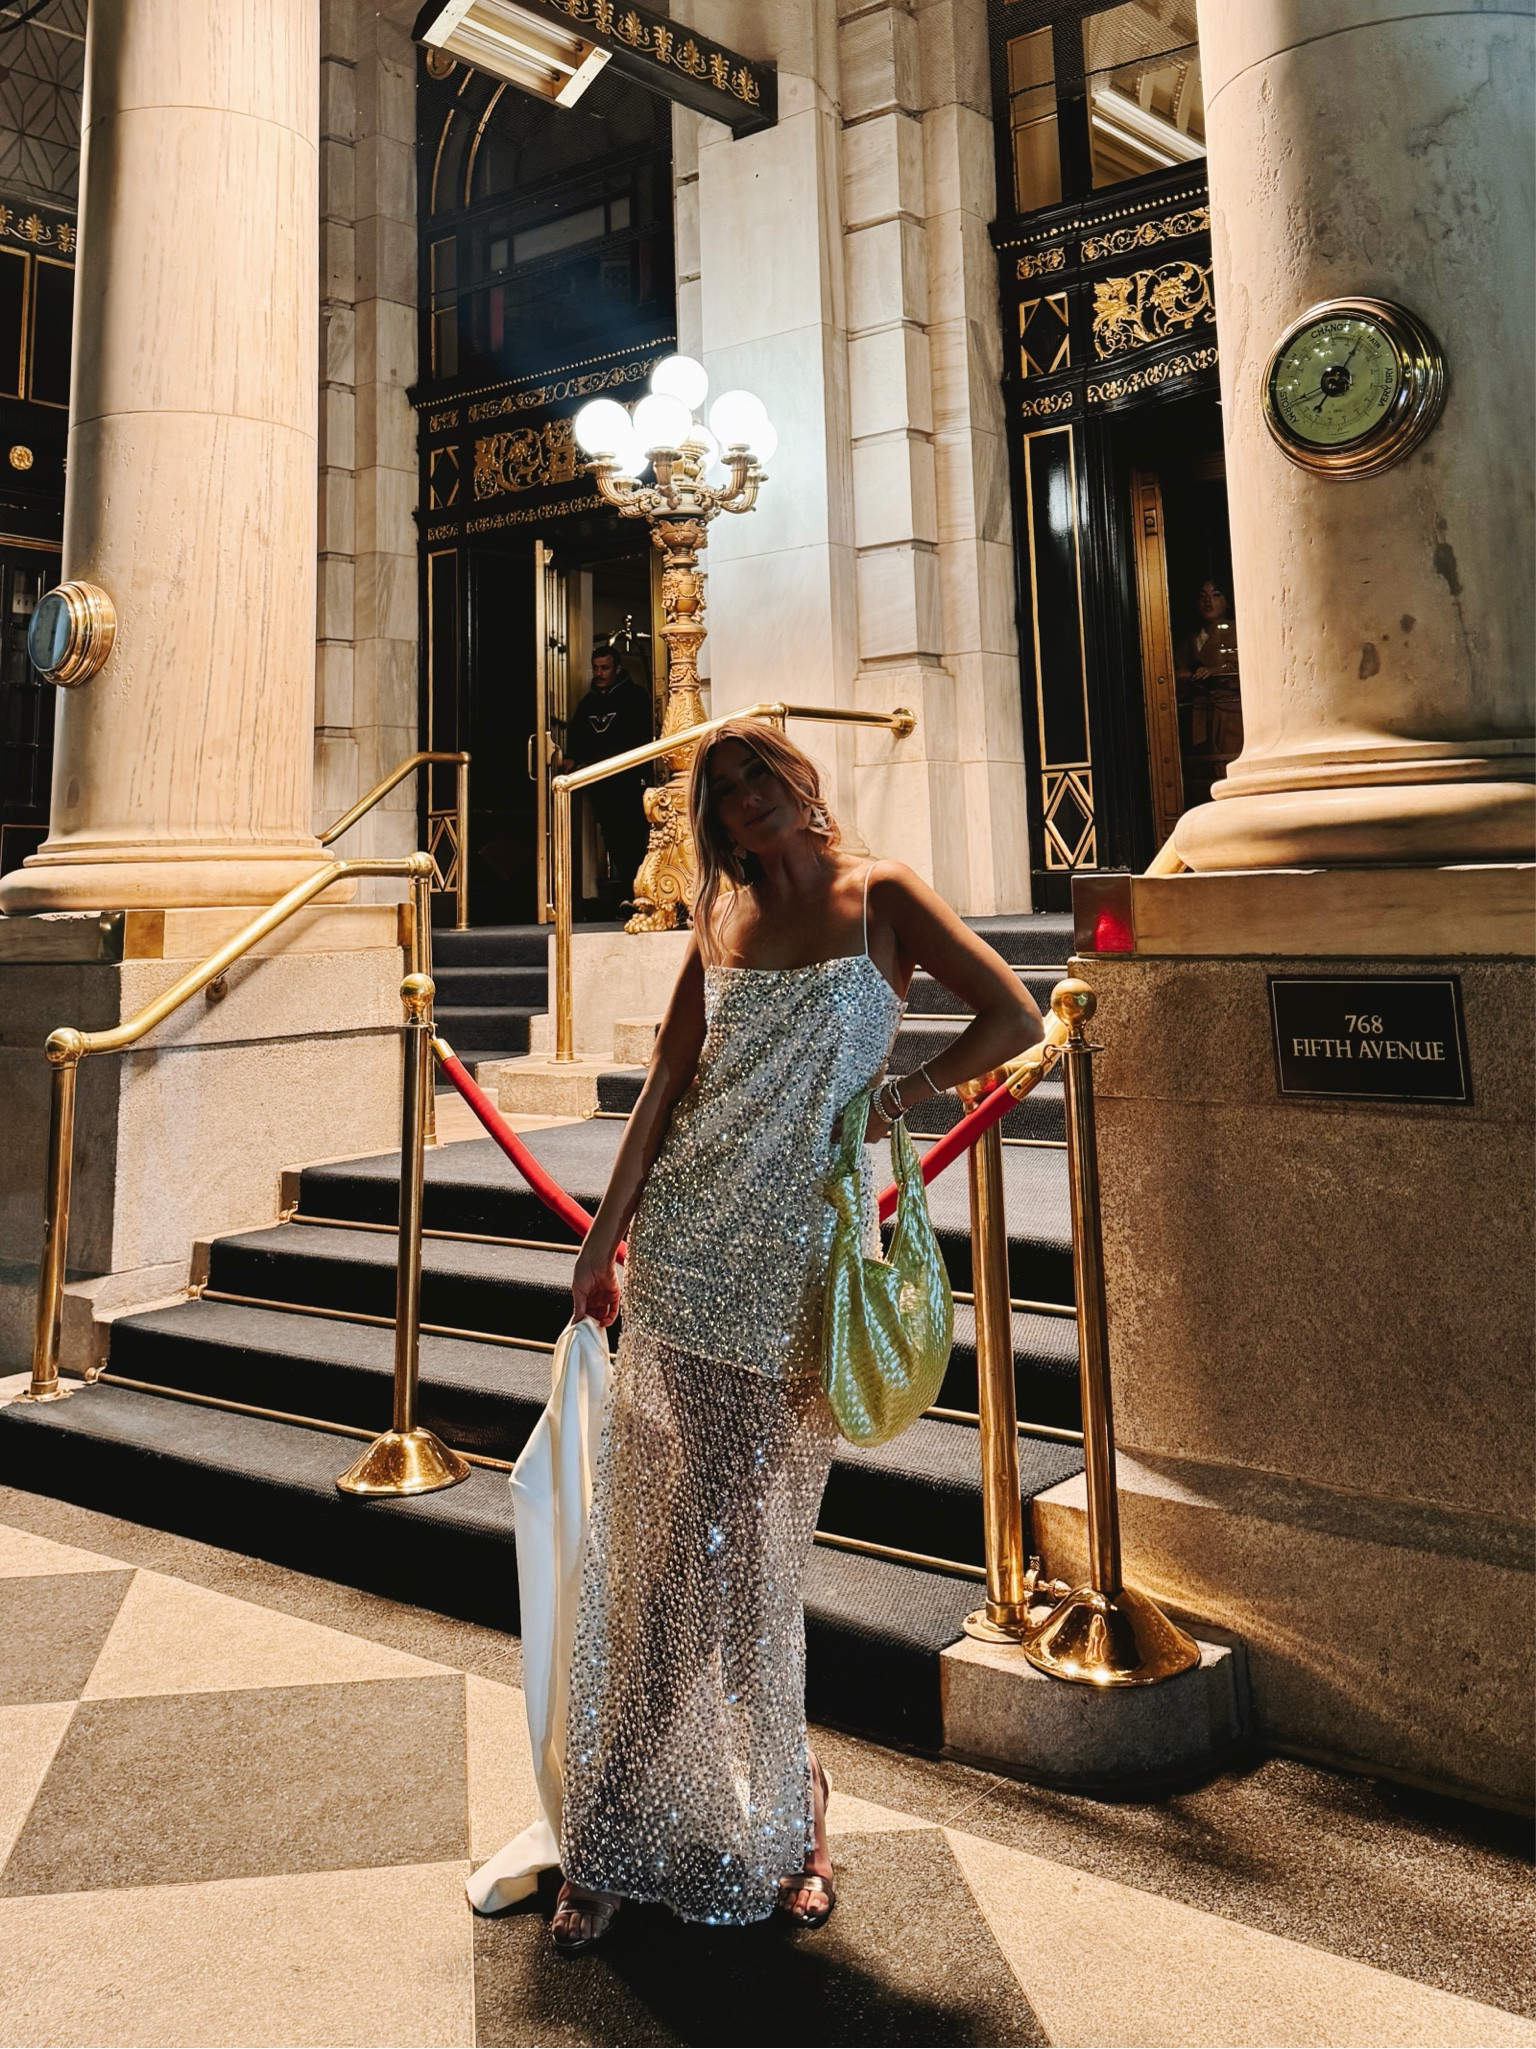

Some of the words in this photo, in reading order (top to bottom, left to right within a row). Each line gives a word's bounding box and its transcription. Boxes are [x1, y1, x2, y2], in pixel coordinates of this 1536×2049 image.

[1367, 335, 1381, 349] FAIR
[1378, 385, 1392, 407] VERY
[1385, 367, 1394, 384] DRY
[1280, 391, 1298, 424] STORMY
[1344, 1014, 1384, 1034] 768
[1292, 1038, 1352, 1058] FIFTH
[1358, 1040, 1446, 1061] AVENUE
